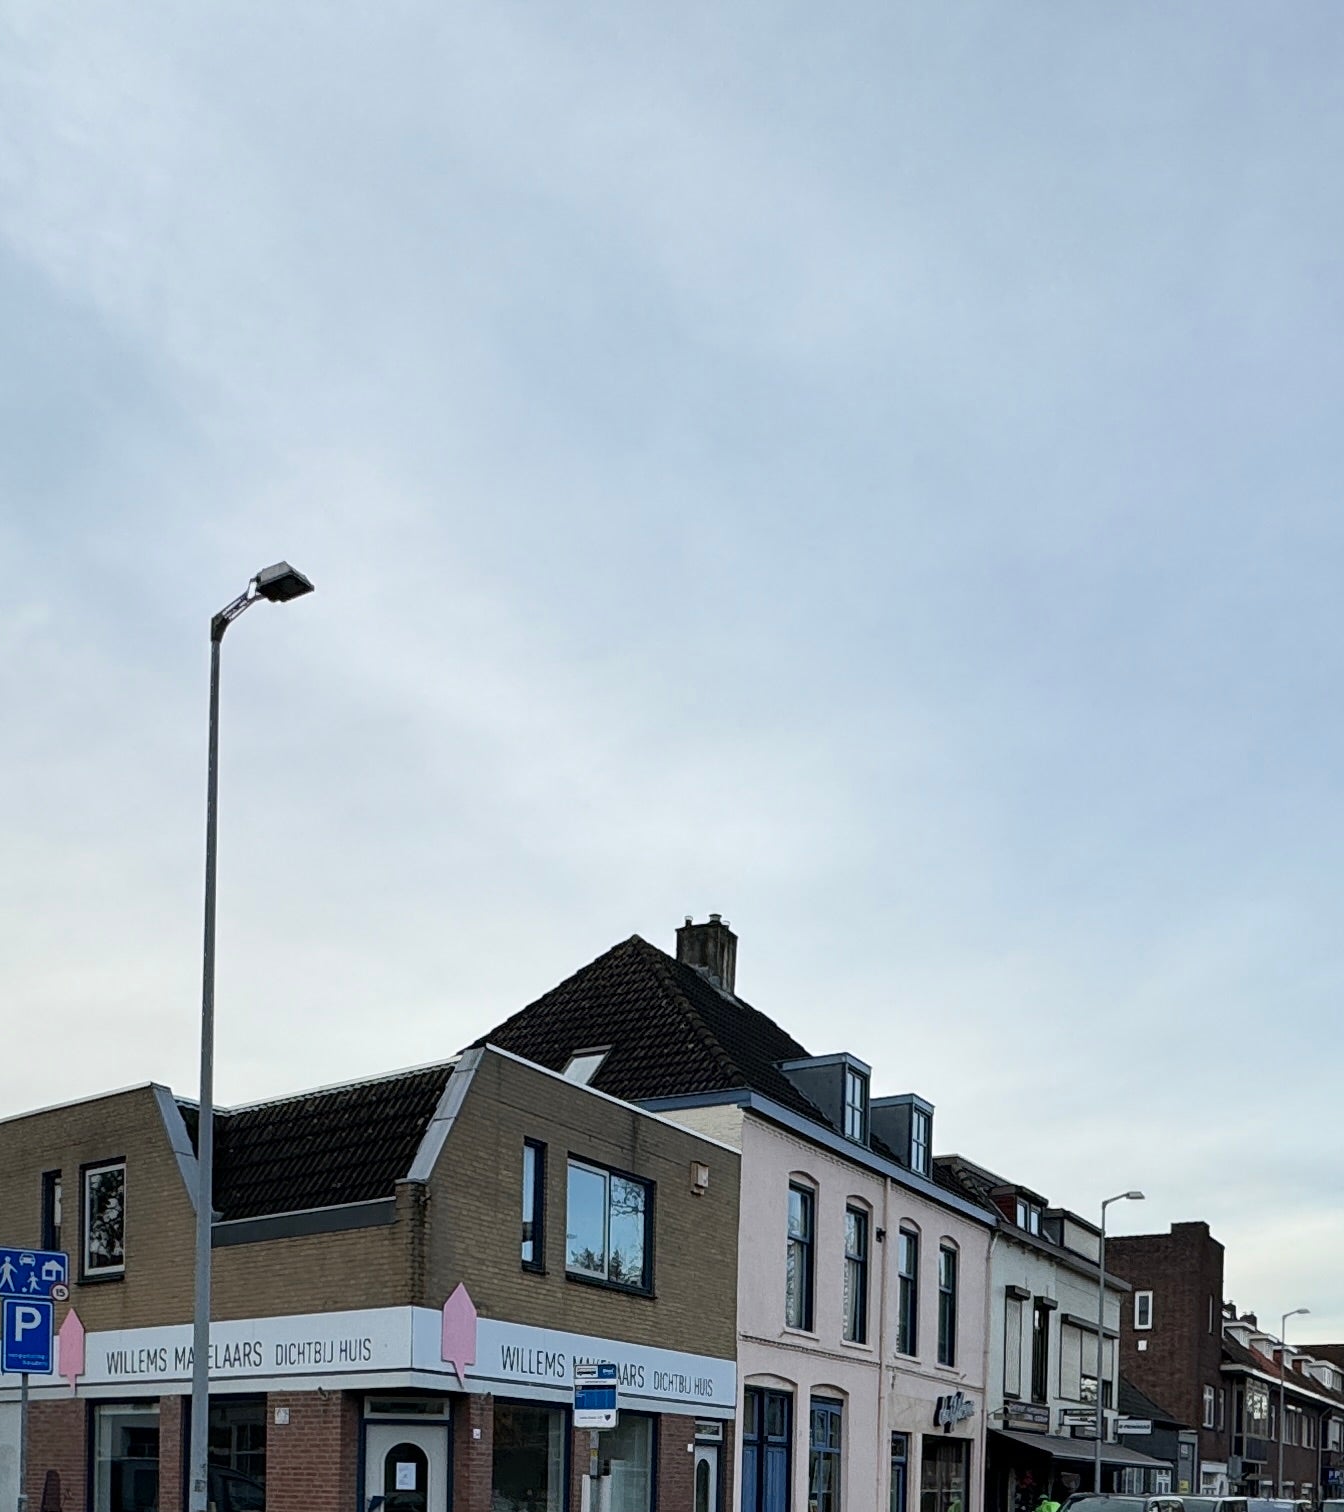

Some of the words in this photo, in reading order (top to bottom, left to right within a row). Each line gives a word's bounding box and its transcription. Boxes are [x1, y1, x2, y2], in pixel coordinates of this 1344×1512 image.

[56, 1288, 66, 1298] 15
[15, 1306, 42, 1342] P
[106, 1348, 167, 1374] WILLEMS
[174, 1341, 263, 1371] MAELAARS
[275, 1341, 334, 1366] DICHTBIJ
[339, 1338, 372, 1362] HUIS
[501, 1345, 565, 1378] WILLEMS
[653, 1370, 691, 1395] DICHTBIJ
[694, 1376, 714, 1398] HUIS
